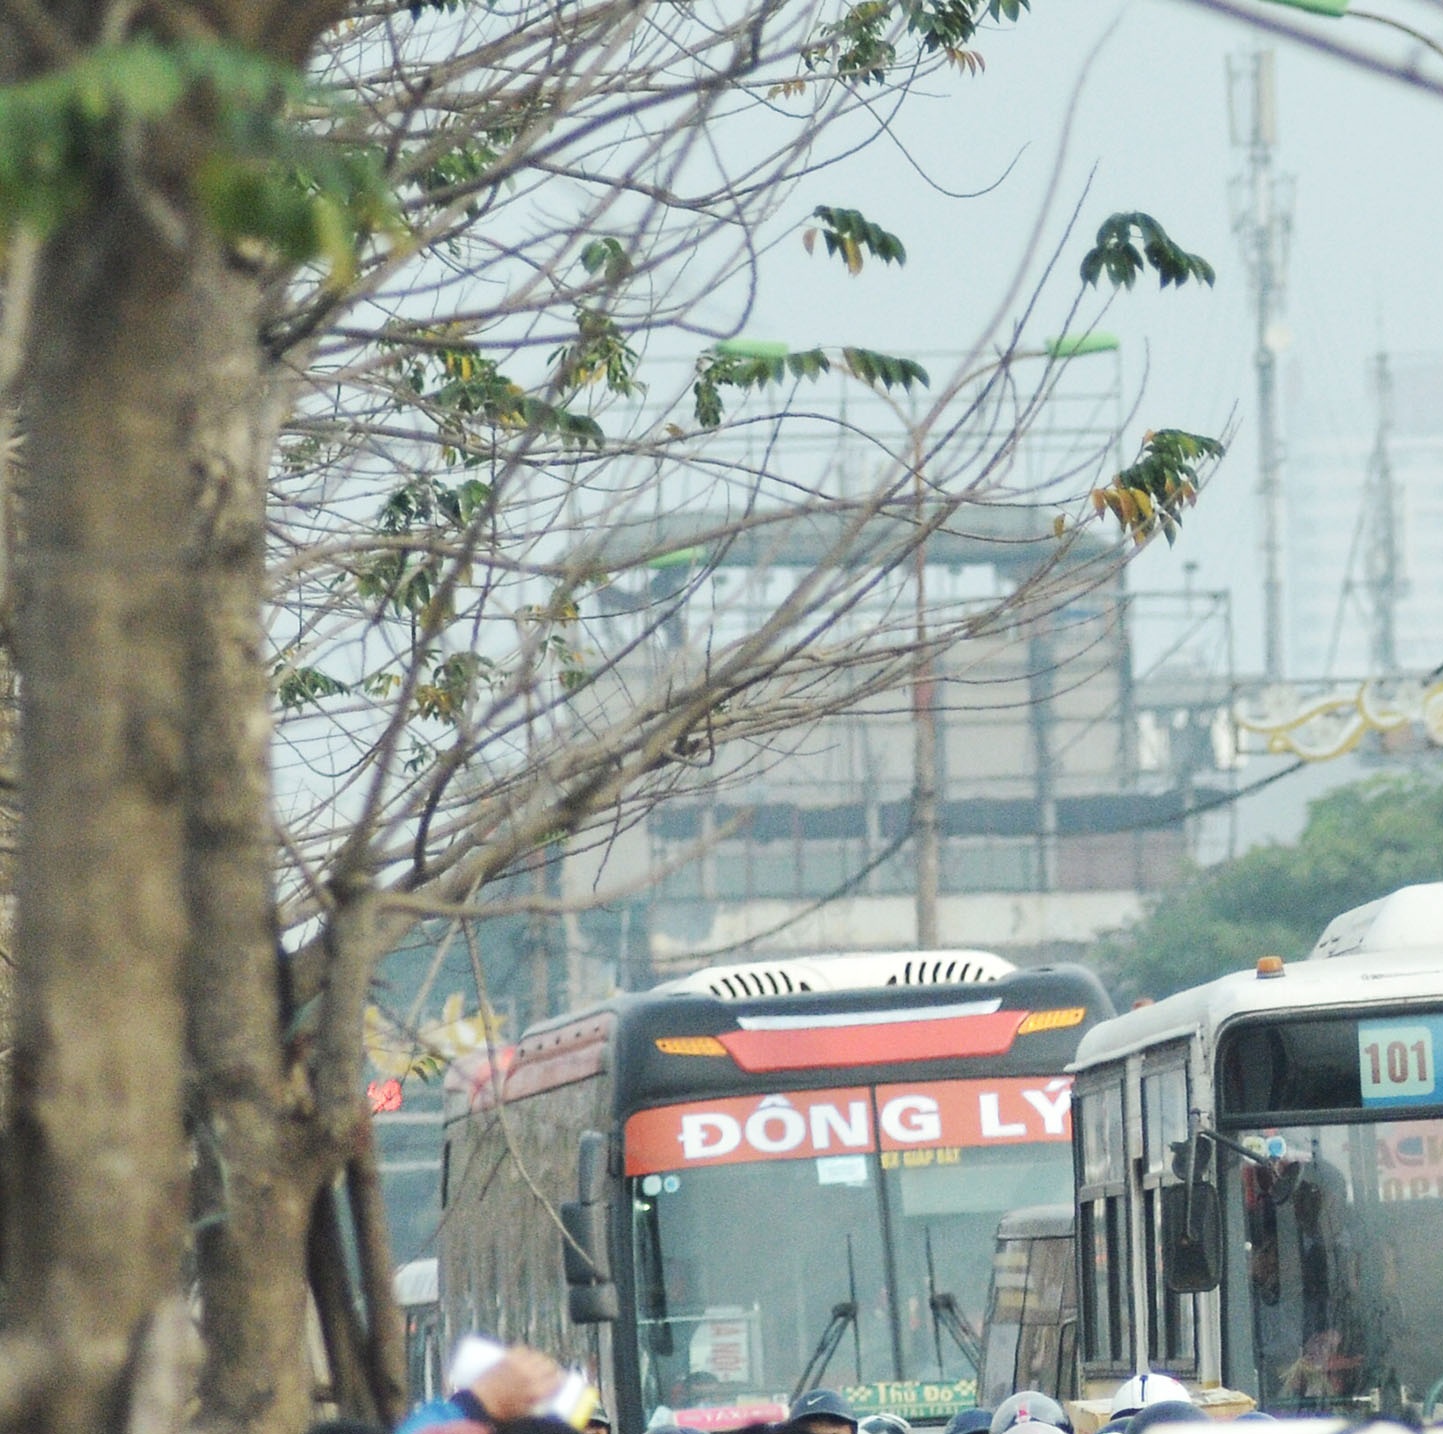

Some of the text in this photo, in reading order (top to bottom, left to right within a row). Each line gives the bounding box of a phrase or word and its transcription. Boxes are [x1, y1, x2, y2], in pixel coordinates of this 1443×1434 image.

[1364, 1040, 1428, 1085] 101
[678, 1078, 1072, 1160] ĐÔNG LÝ
